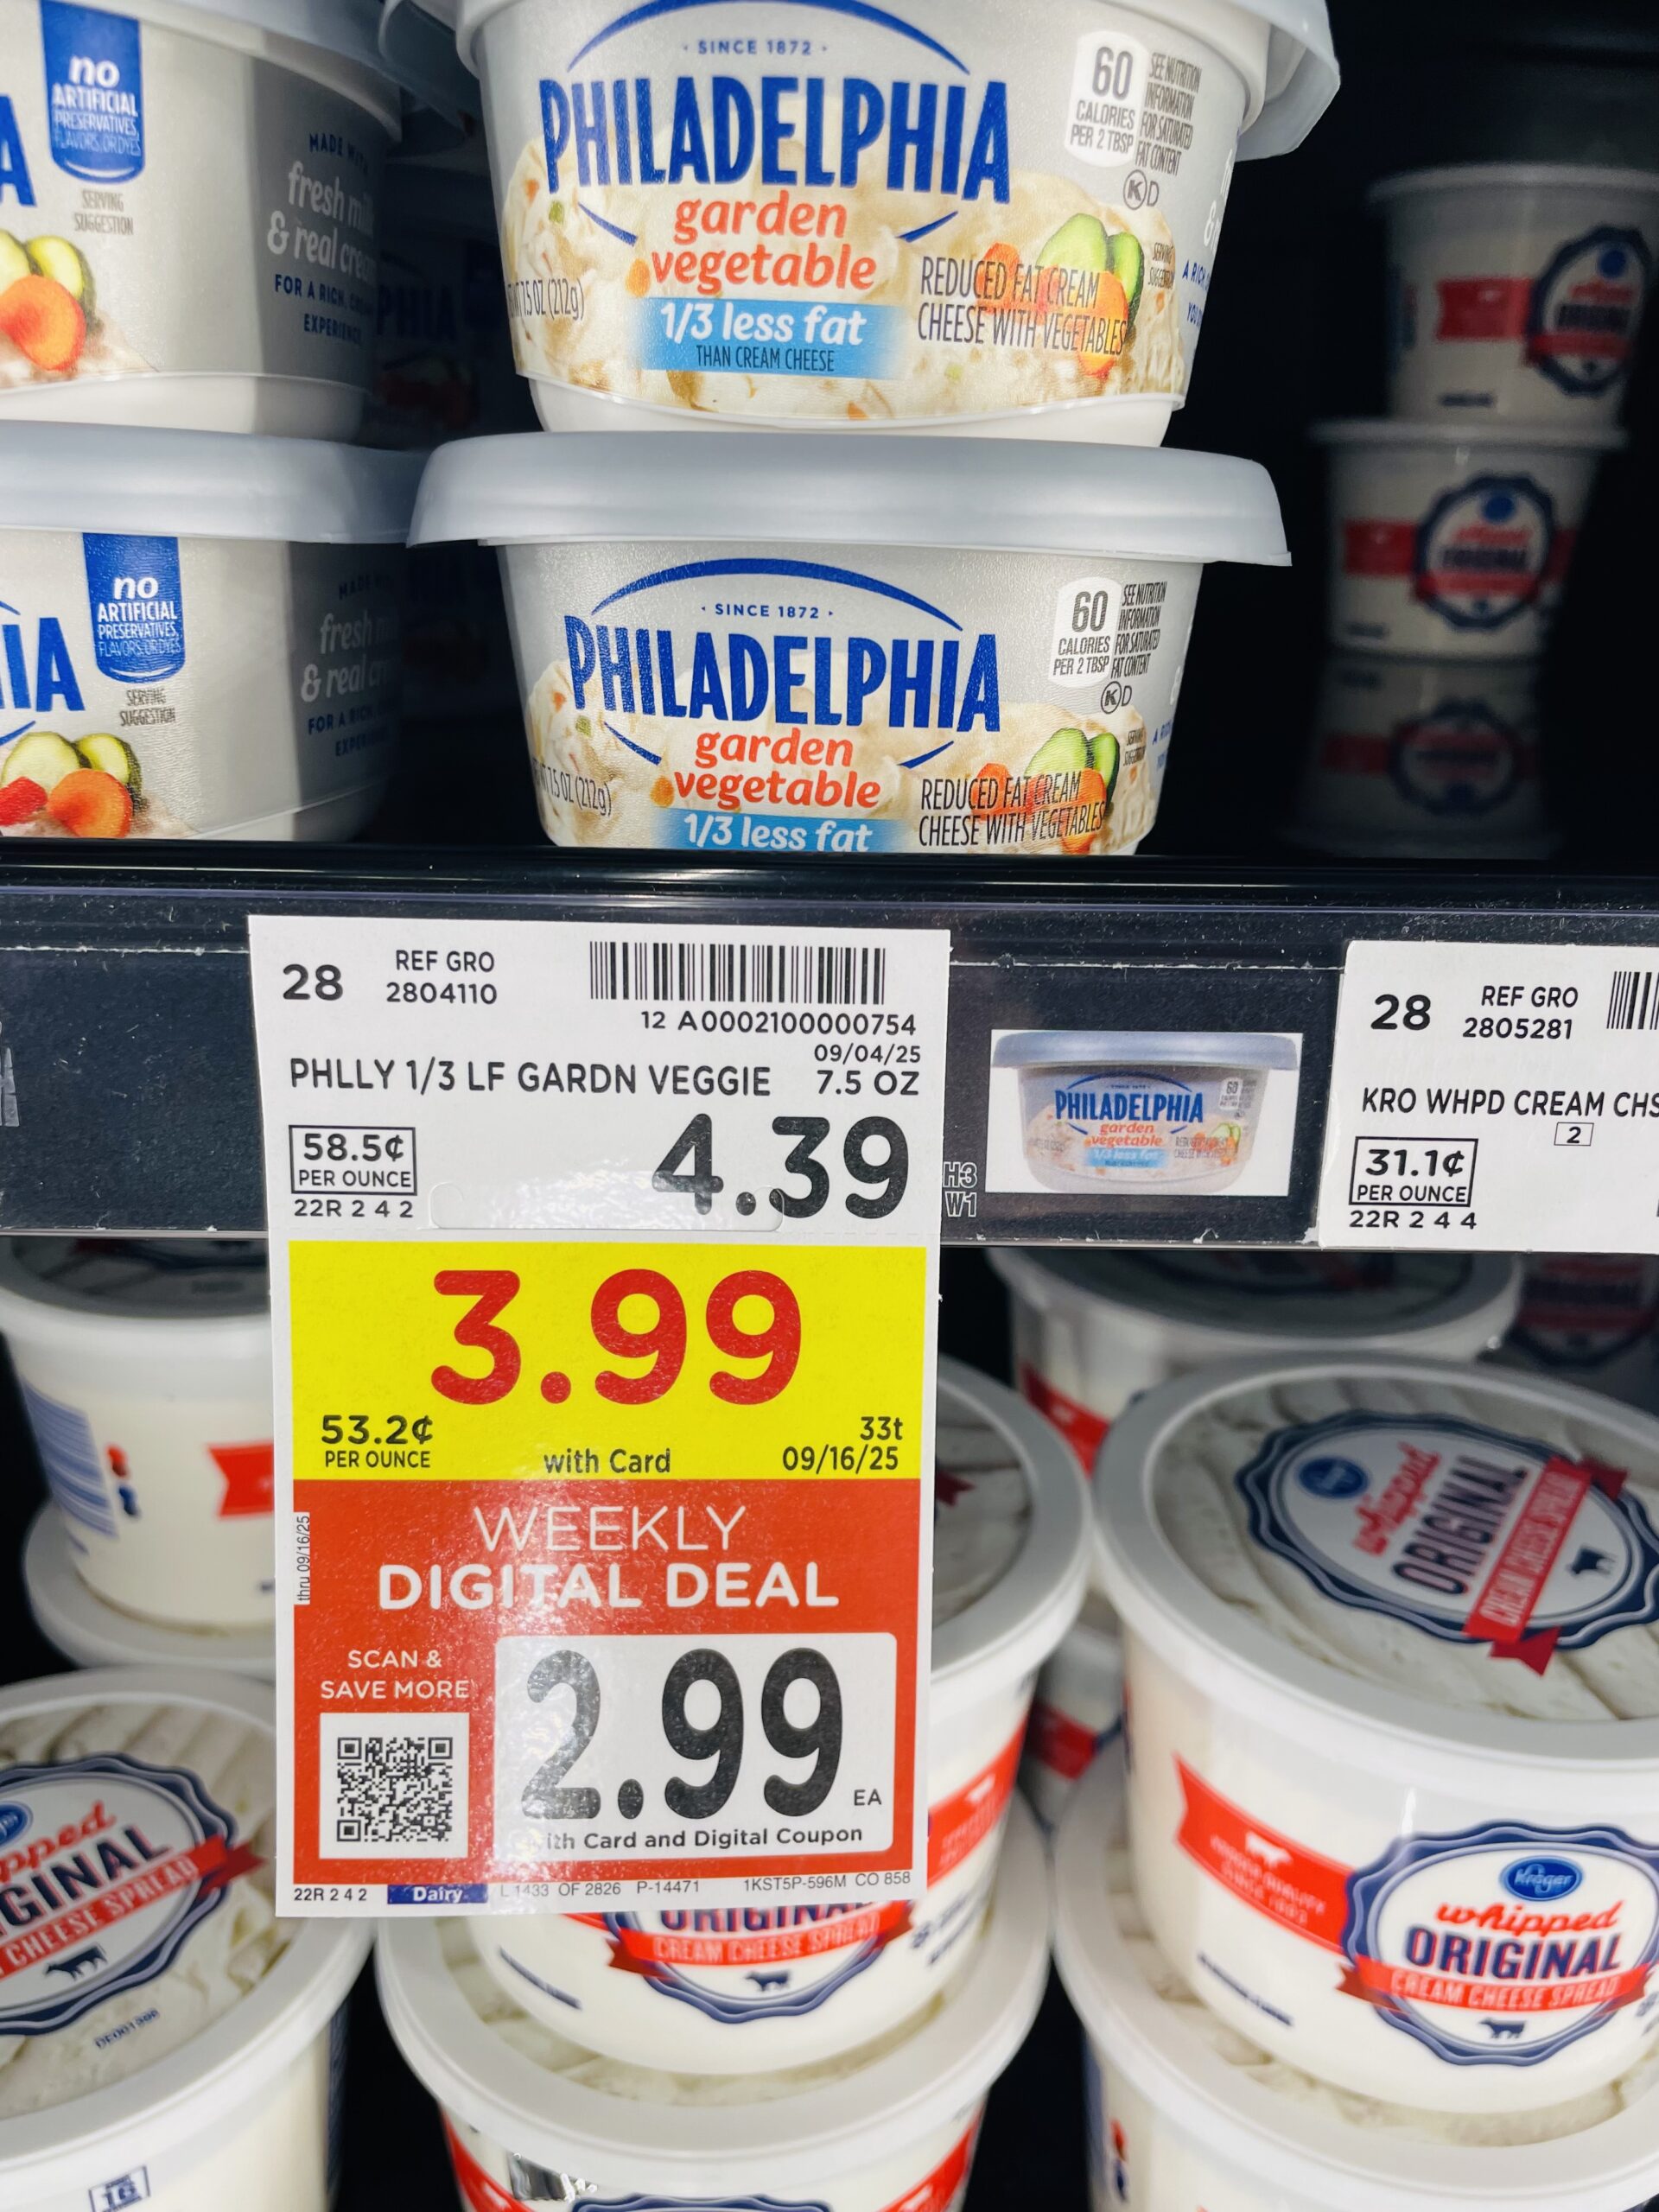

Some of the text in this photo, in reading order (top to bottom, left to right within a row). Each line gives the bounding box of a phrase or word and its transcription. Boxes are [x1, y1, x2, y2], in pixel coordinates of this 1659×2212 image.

[698, 40, 812, 56] SINCE 1872
[69, 55, 120, 87] no
[1091, 47, 1134, 100] 60
[1149, 52, 1202, 93] SEE NUTRITION
[53, 85, 138, 118] ARTIFICIAL
[1076, 100, 1135, 130] CALORIES
[1146, 82, 1194, 121] INFORMATION
[309, 133, 343, 157] MADE
[539, 76, 1010, 205] PHILADELPHIA
[1071, 124, 1135, 154] PER 2 TBSP
[1140, 111, 1193, 151] FOR SATURATED
[1135, 140, 1181, 176] FAT CONTENT
[81, 191, 124, 212] SERVING
[288, 161, 345, 220] fresh
[74, 214, 134, 236] SUGGESTION
[674, 190, 847, 245] garden
[267, 210, 337, 269] & real
[652, 244, 877, 295] vegetable
[921, 257, 1100, 309] REDUCED FAT CREAM
[275, 274, 315, 299] FOR A
[533, 280, 546, 315] OZ
[548, 277, 585, 321] (212g)
[660, 302, 866, 346] 1/3 less fat
[918, 302, 1127, 355] CHEESE WITH VEGETABLES
[696, 345, 835, 372] THAN CREAM CHEESE
[114, 576, 159, 600] no
[1122, 582, 1167, 606] SEE NUTRITION
[97, 602, 178, 622] ARTIFICIAL
[715, 602, 819, 620] SINCE 1872
[1071, 591, 1108, 632] 60
[1118, 606, 1161, 630] INFORMATION
[320, 610, 373, 654] fresh
[1058, 635, 1110, 655] CALORIES
[1115, 630, 1160, 655] FOR SATURATED
[564, 614, 1000, 732] PHILADELPHIA
[1053, 656, 1109, 676] PER 2 TBSP
[1110, 653, 1152, 679] FAT CONTENT
[126, 688, 167, 706] SERVING
[301, 664, 321, 702] &
[120, 708, 176, 728] SUGGESTION
[696, 728, 853, 767] garden
[560, 772, 574, 804] OZ
[575, 776, 612, 817] (212g)
[674, 770, 880, 810] vegetable
[921, 771, 1083, 810] REDUCED FAT CREAM
[684, 813, 873, 852] 1/3 less fat
[919, 800, 1105, 846] CHEESE WITH VEGETABLES
[396, 950, 494, 972] REF GRO
[283, 963, 344, 1001] 28
[386, 982, 498, 1005] 2804110
[1481, 986, 1579, 1007] REF GRO
[641, 1010, 916, 1036] 12 A0002100000754
[1370, 994, 1432, 1030] 28
[1463, 1018, 1573, 1039] 2805281
[814, 1043, 921, 1065] 09/04/25
[290, 1057, 919, 1096] PHLLY 1/3 LF GARDN VEGGIE 7.5 OZ
[1054, 1090, 1204, 1123] PHILADELPHIA
[1362, 1087, 1659, 1118] KRO WHPD CREAM CHS
[1090, 1135, 1163, 1148] vegetable
[1099, 1122, 1154, 1135] garden
[1567, 1127, 1581, 1144] 2
[303, 1133, 404, 1162] 58.5¢
[299, 1170, 411, 1187] PER OUNCE
[652, 1113, 909, 1220] 4.39
[943, 1162, 977, 1188] H3
[1365, 1149, 1465, 1178] 31.1¢
[294, 1199, 413, 1217] 22R 2 4 2
[945, 1192, 976, 1217] W1
[1357, 1185, 1467, 1203] PER OUNCE
[1349, 1211, 1477, 1230] 22R 2 4 4
[431, 1268, 801, 1405] 3.99
[321, 1414, 433, 1446] 53.2¢
[860, 1416, 903, 1440] 33t
[325, 1451, 430, 1468] PER OUNCE
[543, 1448, 671, 1473] with Card
[782, 1445, 899, 1475] 09/16/25
[474, 1506, 747, 1553] WEEKLY
[1392, 1455, 1528, 1595] ORIGINAL
[296, 1516, 310, 1601] thru 09/16/25
[379, 1561, 839, 1610] DIGITAL DEAL
[347, 1649, 442, 1669] SCAN &
[320, 1681, 469, 1700] SAVE MORE
[521, 1648, 842, 1819] 2.99
[853, 1789, 882, 1807] EA
[584, 1826, 862, 1851] Card and Digital Coupon
[558, 1872, 911, 1896] OF 2826 P-14471 1KST5P-596M CO 858
[1513, 1863, 1571, 1894] Kroger
[294, 1888, 367, 1901] 22R 2 4 2
[412, 1886, 463, 1903] Dairy
[5, 1854, 198, 1967] CHEESE SPREAD
[1435, 1900, 1624, 1937] whipped
[653, 1936, 723, 1963] CREAM
[728, 1932, 804, 1962] CHEESE
[810, 1911, 880, 1952] SPREAD
[1405, 1926, 1622, 1980] ORIGINAL
[1391, 1970, 1619, 2009] CREAM CHEESE SPREAD
